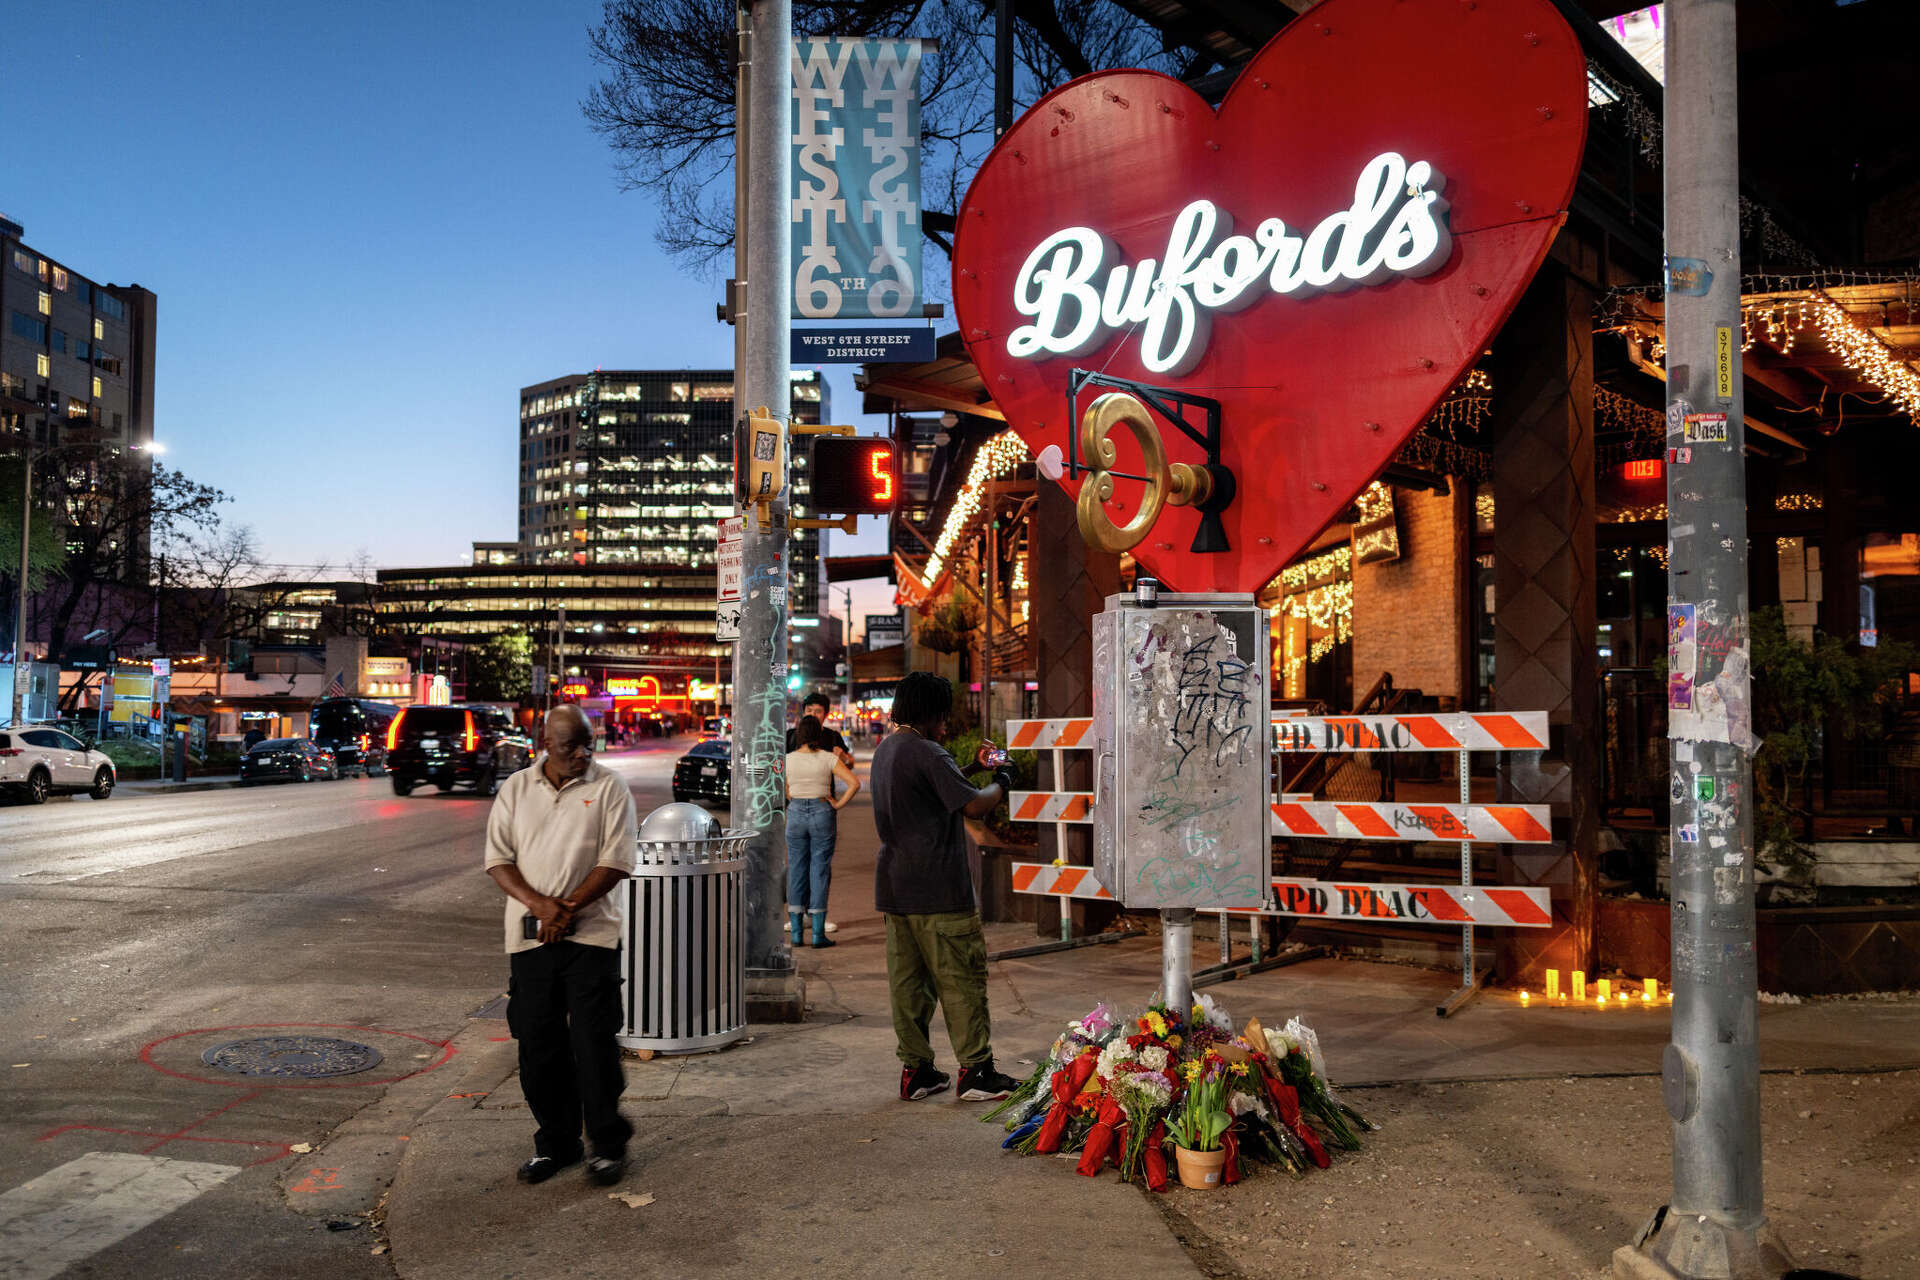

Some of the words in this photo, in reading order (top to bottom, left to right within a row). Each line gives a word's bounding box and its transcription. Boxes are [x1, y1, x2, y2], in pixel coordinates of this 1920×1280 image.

[1006, 151, 1443, 373] Buford's
[802, 336, 836, 345] WEST
[838, 335, 862, 345] 6TH
[865, 335, 911, 345] STREET
[827, 348, 886, 357] DISTRICT
[1719, 331, 1729, 393] 376608
[871, 450, 893, 500] 5
[724, 574, 738, 585] ONLY
[1272, 724, 1311, 750] PD
[1323, 722, 1411, 750] DTAC
[1264, 886, 1328, 914] APD
[1341, 888, 1429, 919] DTAC
